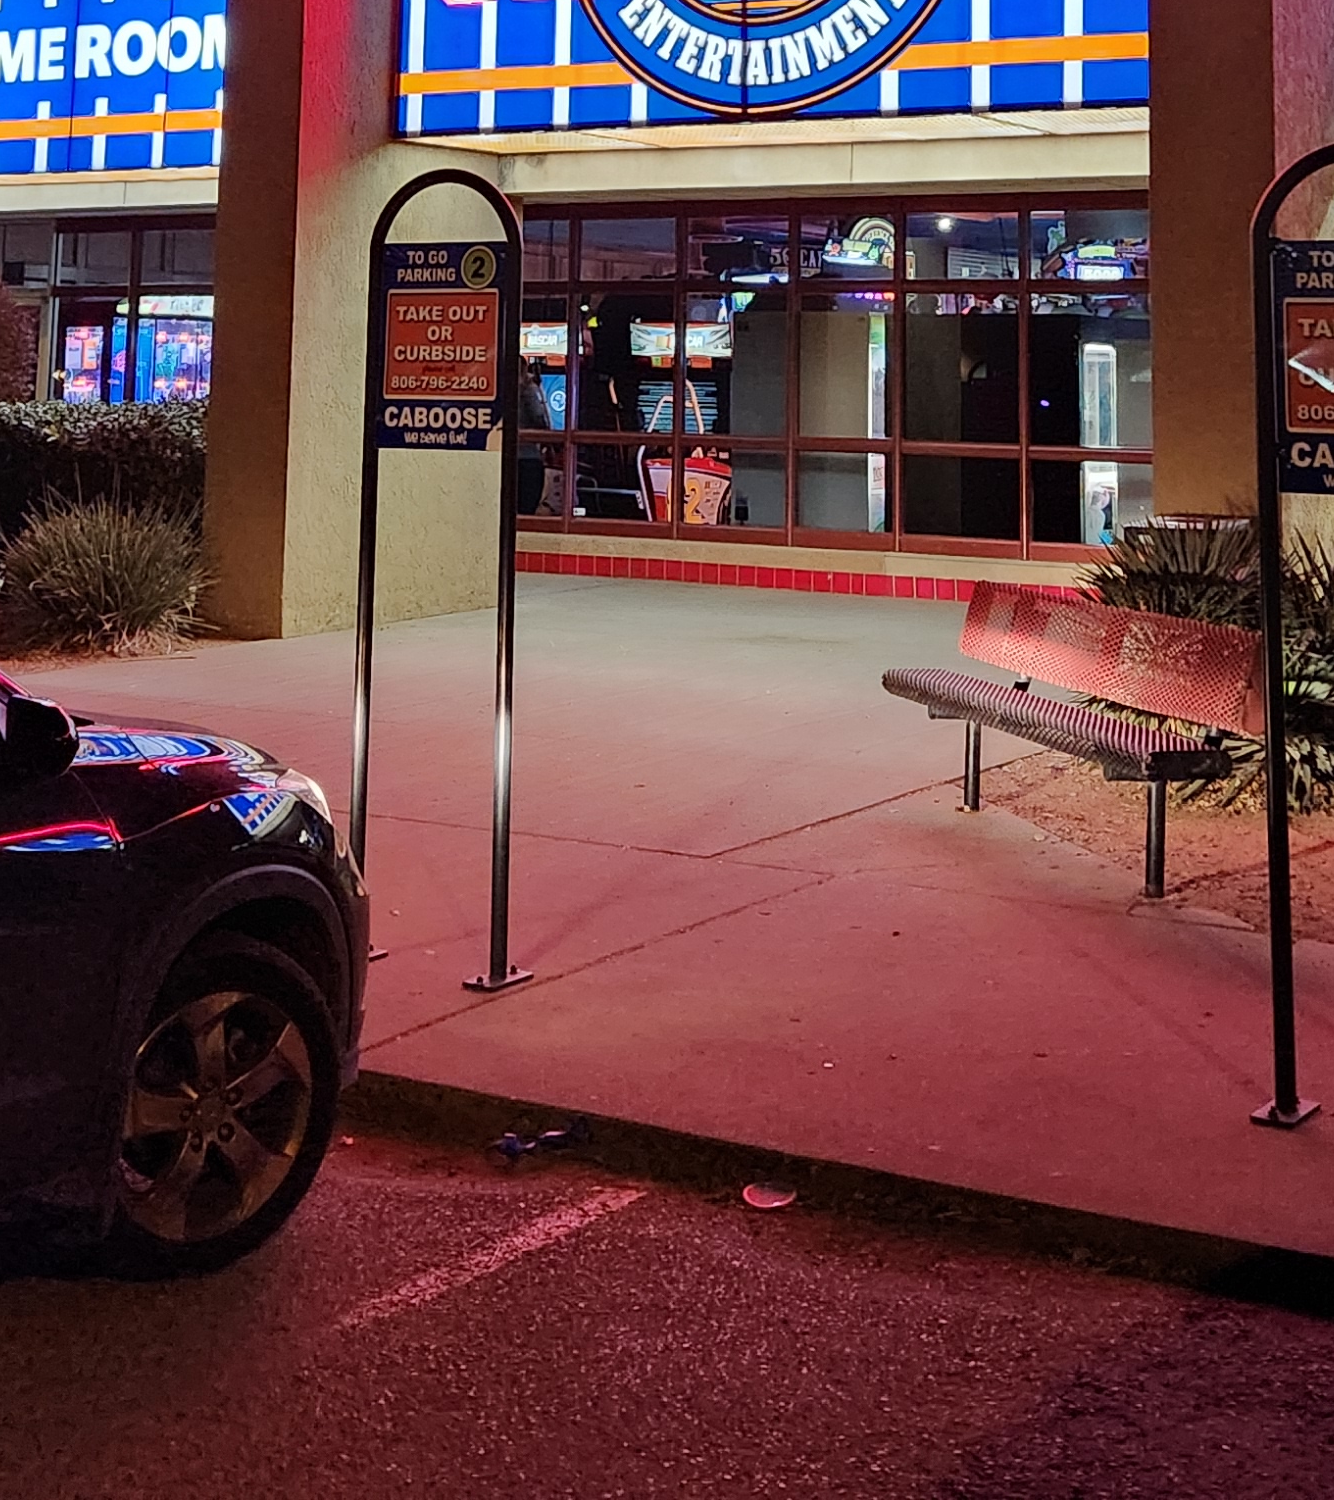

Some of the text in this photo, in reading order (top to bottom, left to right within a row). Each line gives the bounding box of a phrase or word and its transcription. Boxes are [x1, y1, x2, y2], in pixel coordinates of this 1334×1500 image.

[407, 250, 448, 265] TO GO
[396, 268, 456, 282] PARKING
[470, 256, 486, 279] 2
[395, 306, 487, 321] TAKE OUT
[427, 326, 453, 341] OR
[394, 346, 486, 361] CURBSIDE
[391, 376, 487, 390] 806-796-2240
[384, 406, 492, 429] CABOOSE
[420, 432, 447, 445] serve
